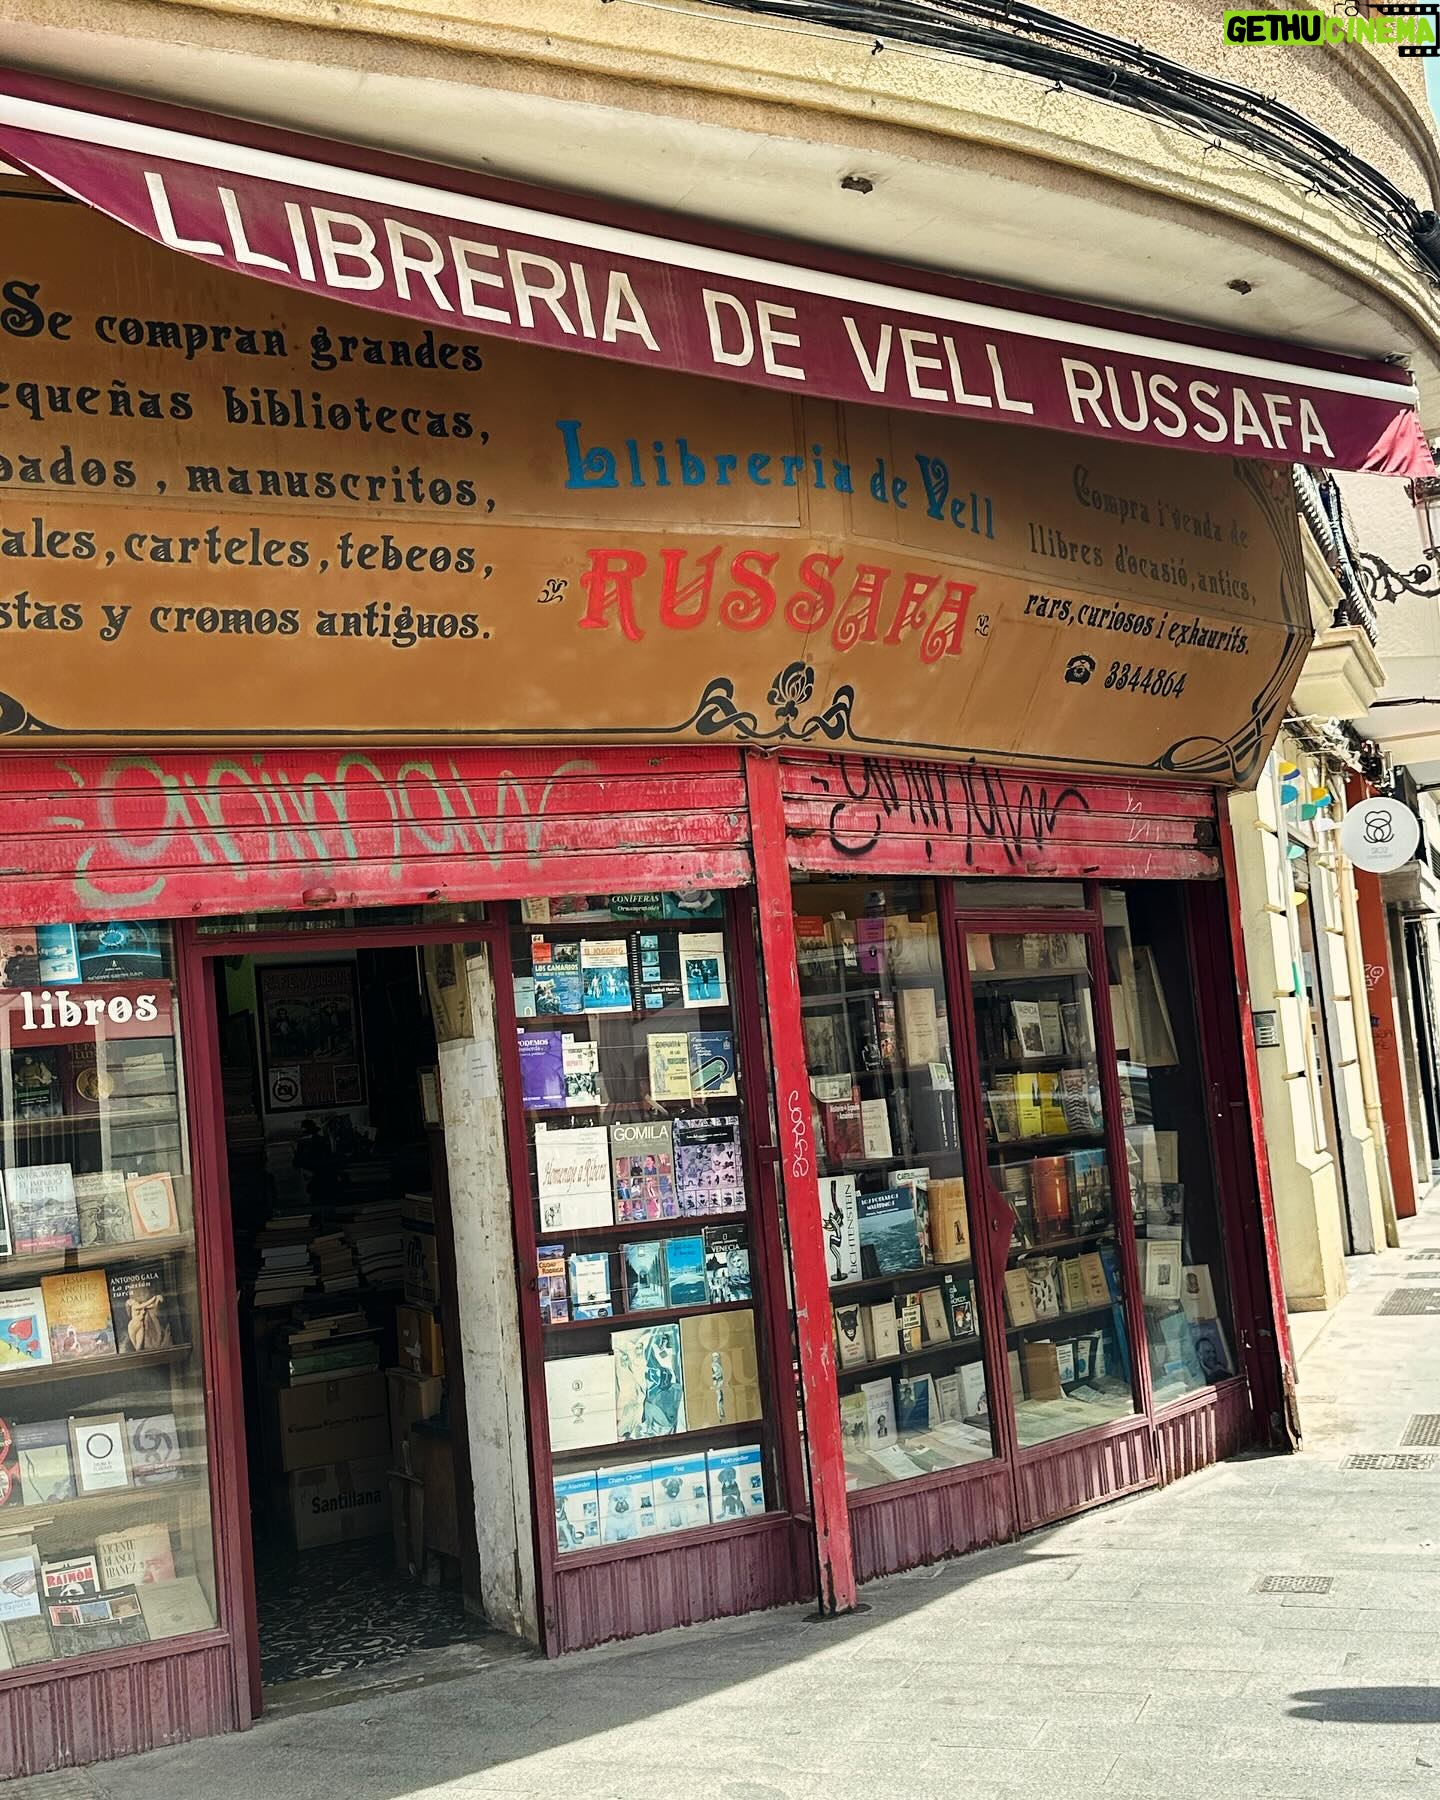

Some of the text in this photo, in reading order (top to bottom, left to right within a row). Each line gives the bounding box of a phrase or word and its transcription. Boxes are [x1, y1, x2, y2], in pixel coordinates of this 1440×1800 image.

[1, 280, 483, 371] Se compran grandes
[143, 171, 1334, 459] LLIBRERIA DE VELL RUSSAFA
[222, 386, 489, 446] bibliotecas,
[186, 465, 496, 514] manuscritos,
[555, 420, 996, 540] Llibreria de Vell
[1073, 464, 1150, 524] Compra
[1230, 519, 1249, 549] de
[1029, 523, 1104, 567] llibres
[100, 605, 132, 641] y
[149, 606, 299, 635] cromos
[315, 601, 490, 648] antiguos.
[578, 546, 978, 665] RUSSAFA
[1077, 601, 1155, 637] curiosos
[1156, 612, 1168, 640] i
[1104, 661, 1187, 698] 3344864
[20, 991, 158, 1030] libros
[614, 1126, 669, 1141] GOMILA
[711, 1244, 740, 1252] VENECIA
[110, 1276, 140, 1285] ANTONIO
[312, 1490, 382, 1514] Santillana
[102, 1539, 136, 1553] VICENTE
[104, 1552, 135, 1567] BLASCO
